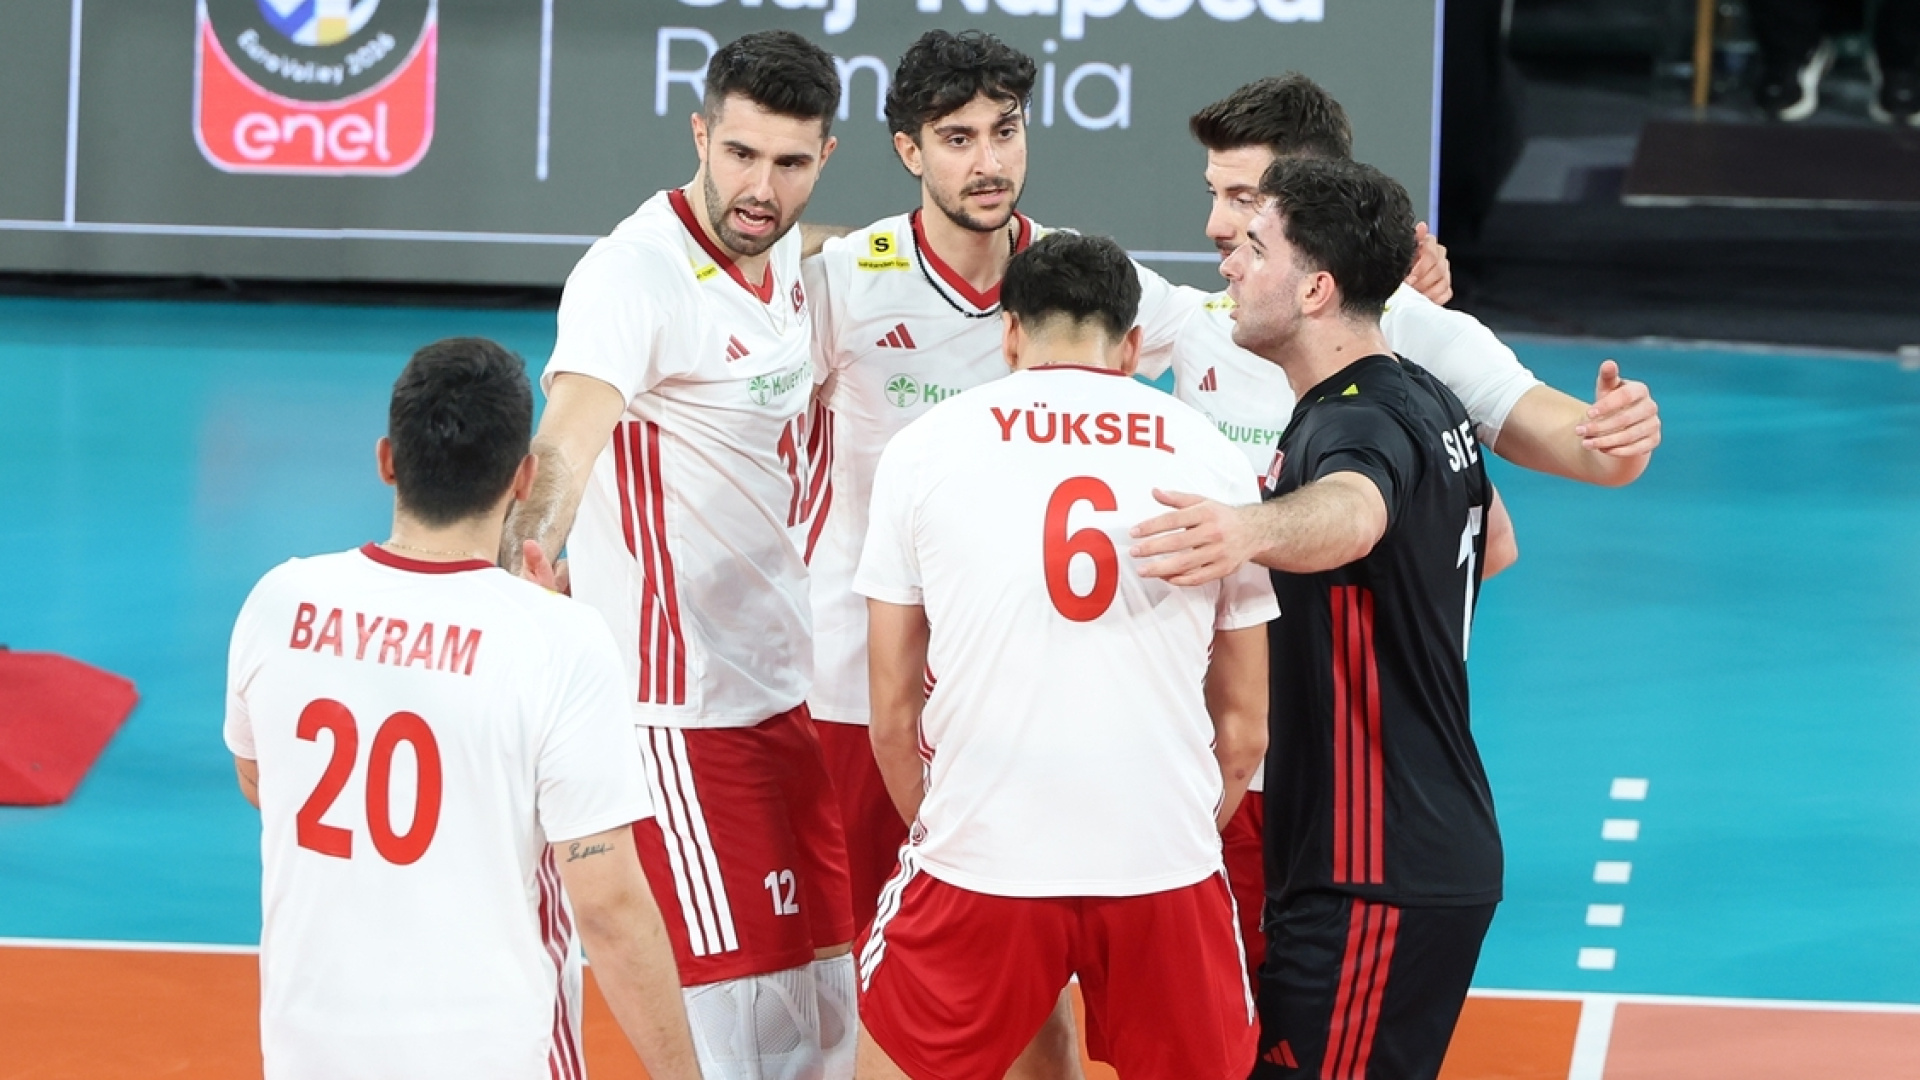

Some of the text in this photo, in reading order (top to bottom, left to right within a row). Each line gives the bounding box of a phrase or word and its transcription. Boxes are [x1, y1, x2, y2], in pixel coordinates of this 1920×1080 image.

[232, 101, 391, 162] enel
[874, 236, 890, 253] S
[990, 402, 1175, 454] YÜKSEL
[1043, 475, 1119, 622] 6
[289, 601, 482, 676] BAYRAM
[296, 697, 443, 866] 20
[764, 868, 800, 916] 12
